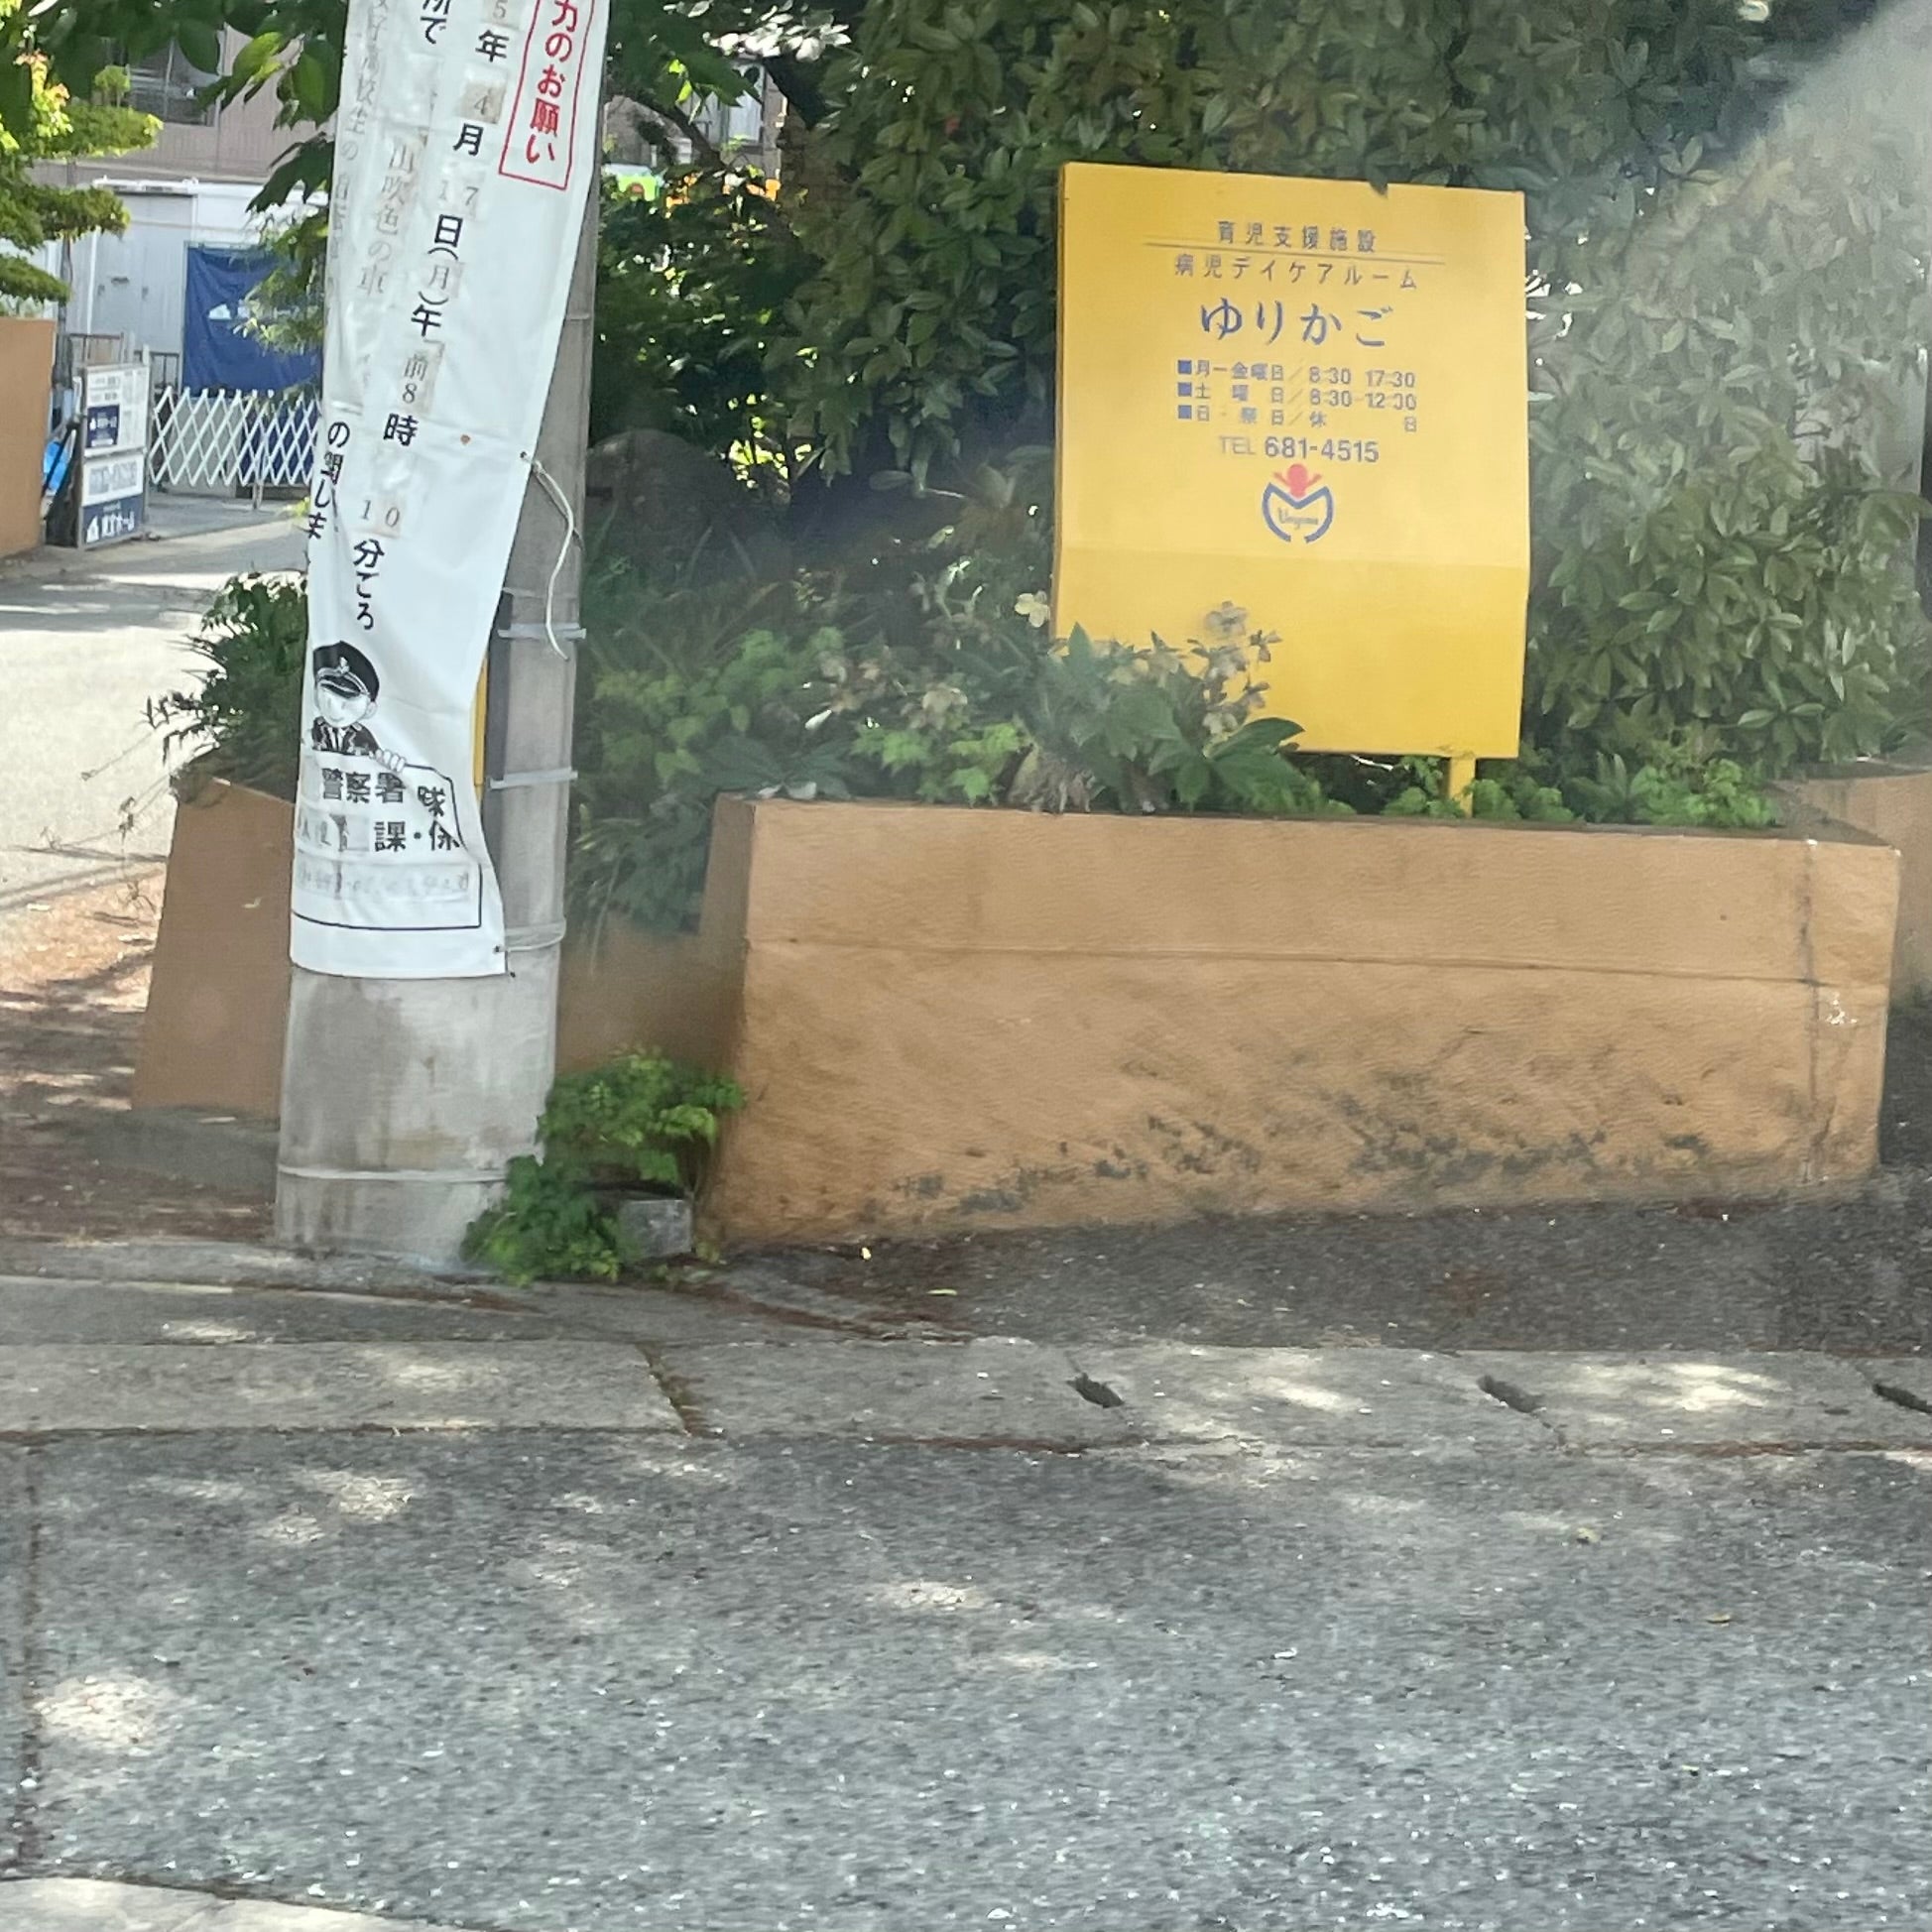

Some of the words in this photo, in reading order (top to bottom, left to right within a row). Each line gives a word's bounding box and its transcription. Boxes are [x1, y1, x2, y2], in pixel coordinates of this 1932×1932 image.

[1217, 220, 1377, 253] 育児支援施設
[1174, 253, 1417, 290] 病児デイケアルーム
[1200, 297, 1394, 347] ゆりかご
[1218, 435, 1256, 456] TEL
[1264, 435, 1380, 463] 681-4515
